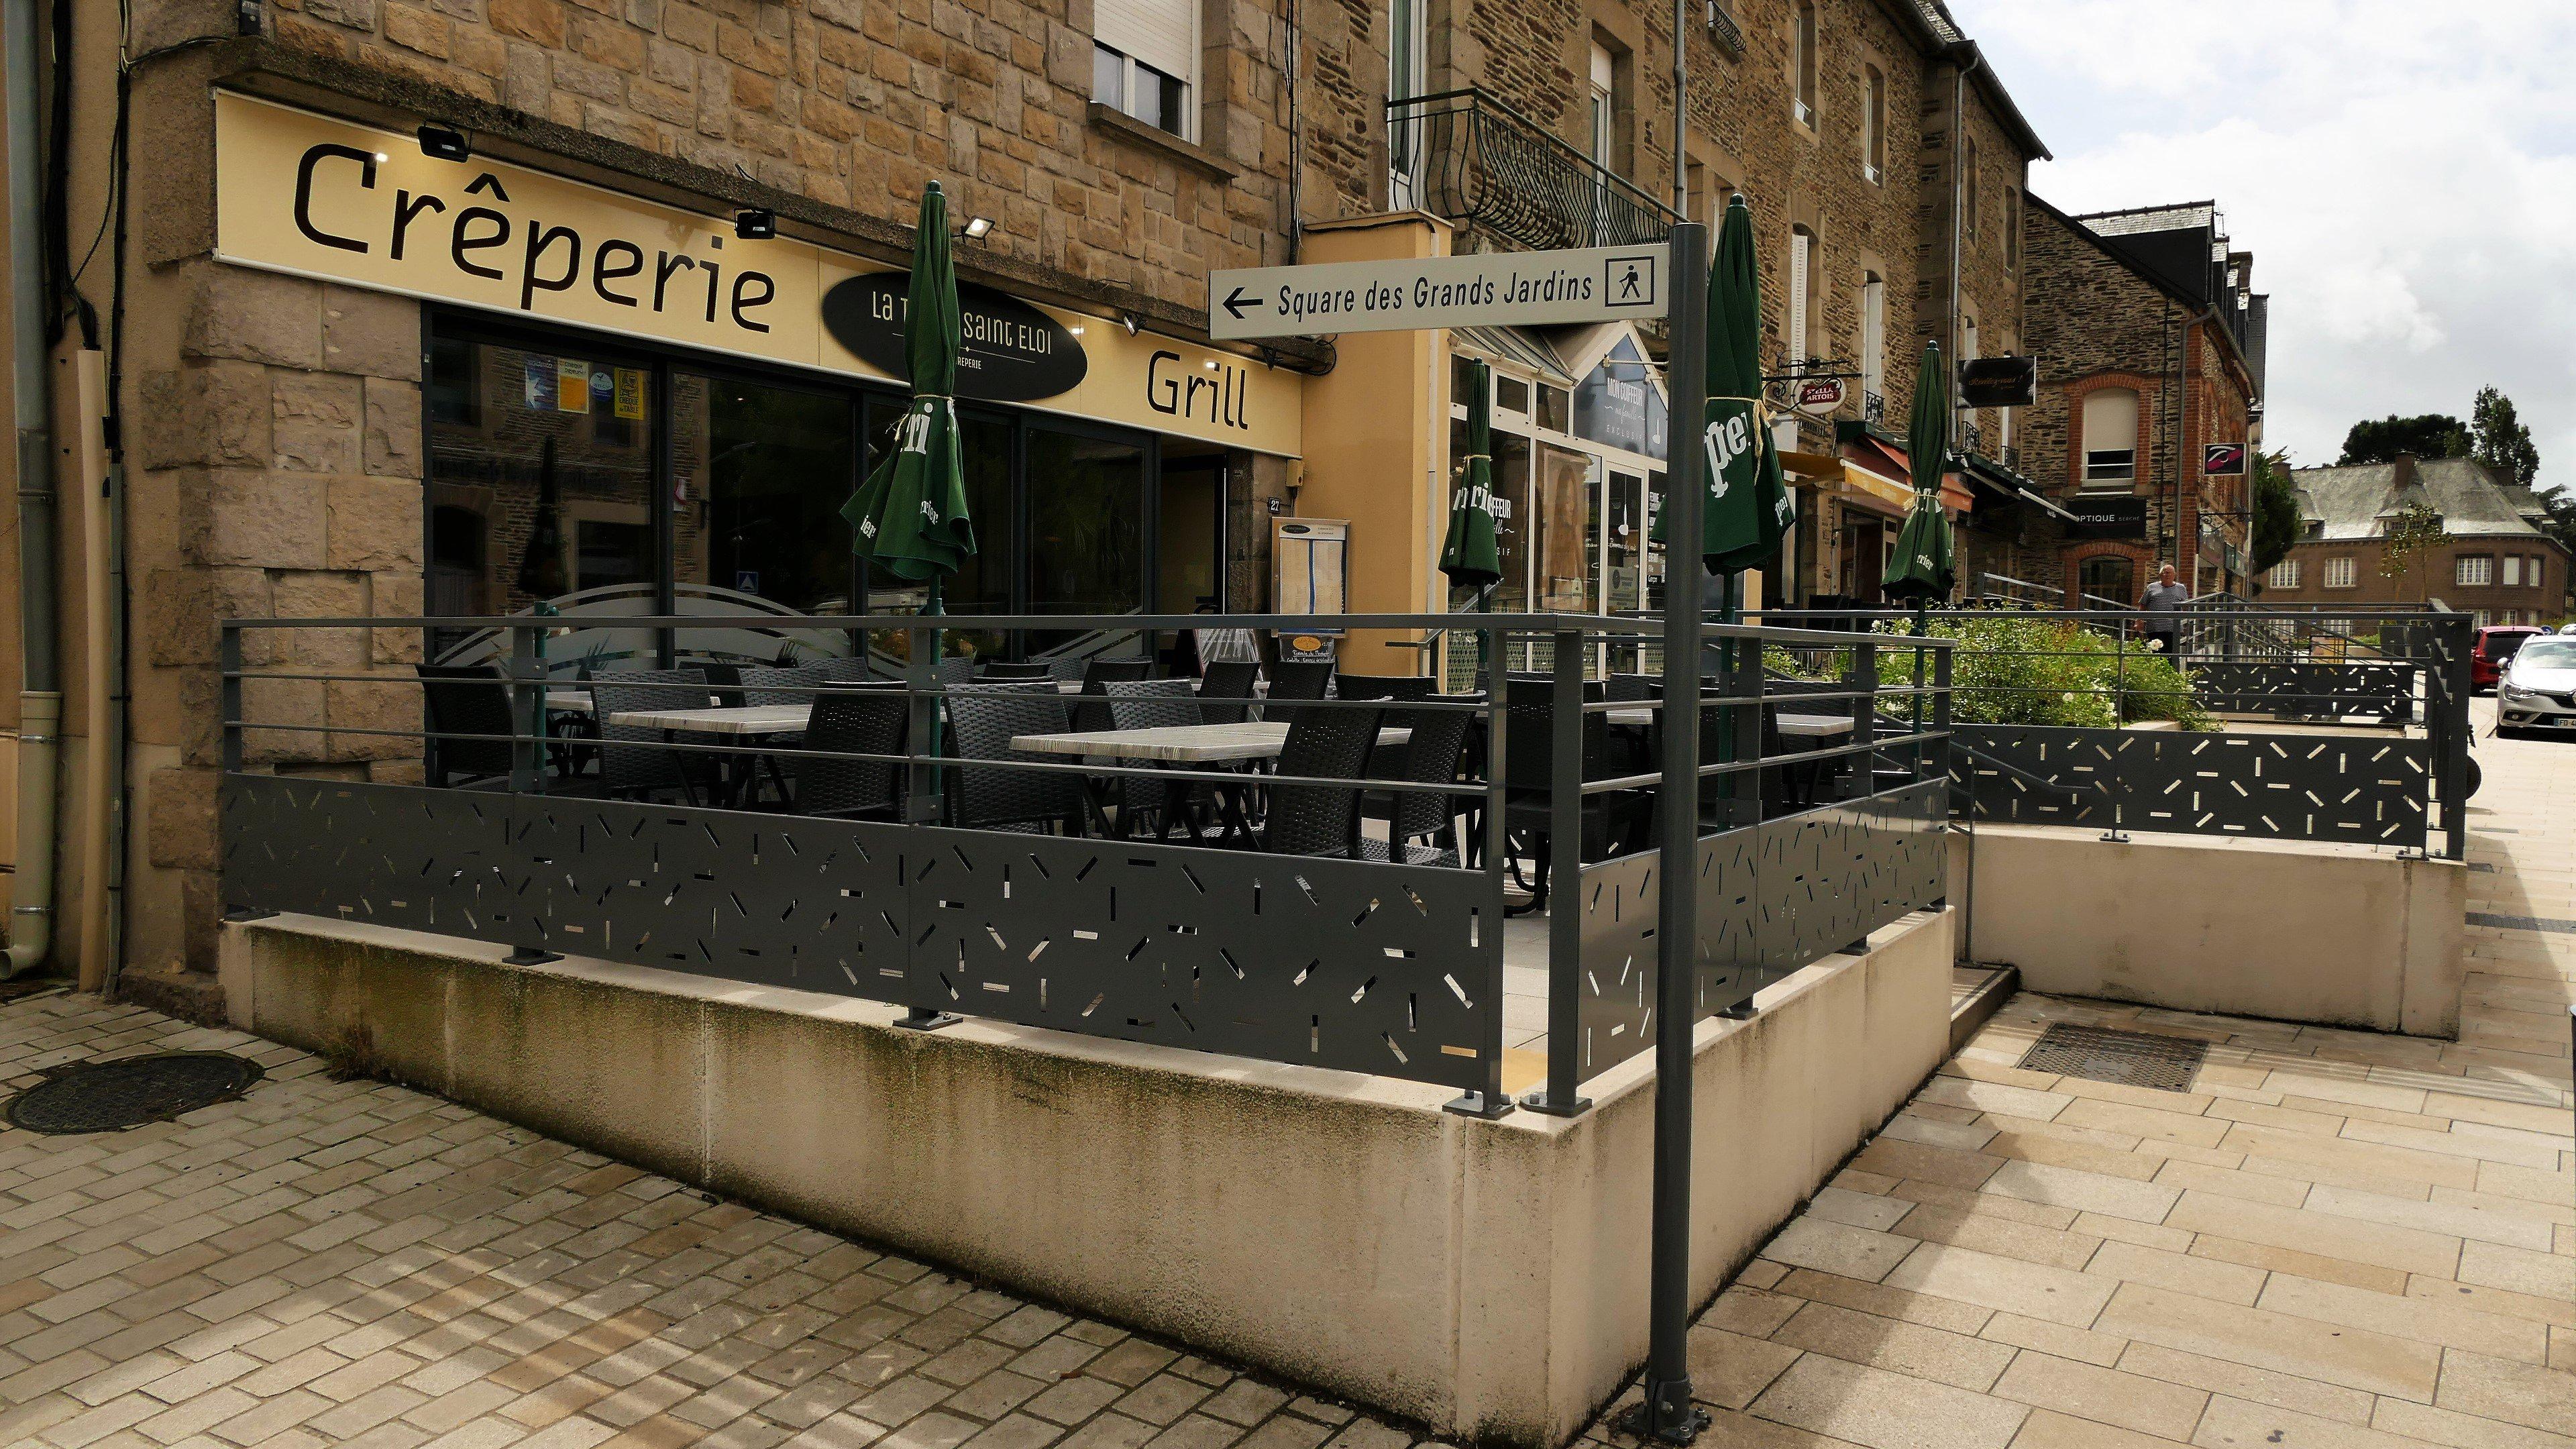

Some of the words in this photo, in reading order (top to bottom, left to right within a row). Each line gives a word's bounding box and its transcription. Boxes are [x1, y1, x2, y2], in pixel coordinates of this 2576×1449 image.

[293, 142, 775, 333] Crêperie
[1277, 284, 1355, 323] Square
[1364, 279, 1403, 310] des
[1413, 274, 1494, 309] Grands
[1503, 268, 1593, 304] Jardins
[956, 356, 982, 370] REPERIE
[1146, 349, 1249, 431] Grill
[1807, 393, 1834, 401] ARTOIS
[1271, 500, 1280, 512] 27
[2076, 515, 2115, 523] PTIQUE
